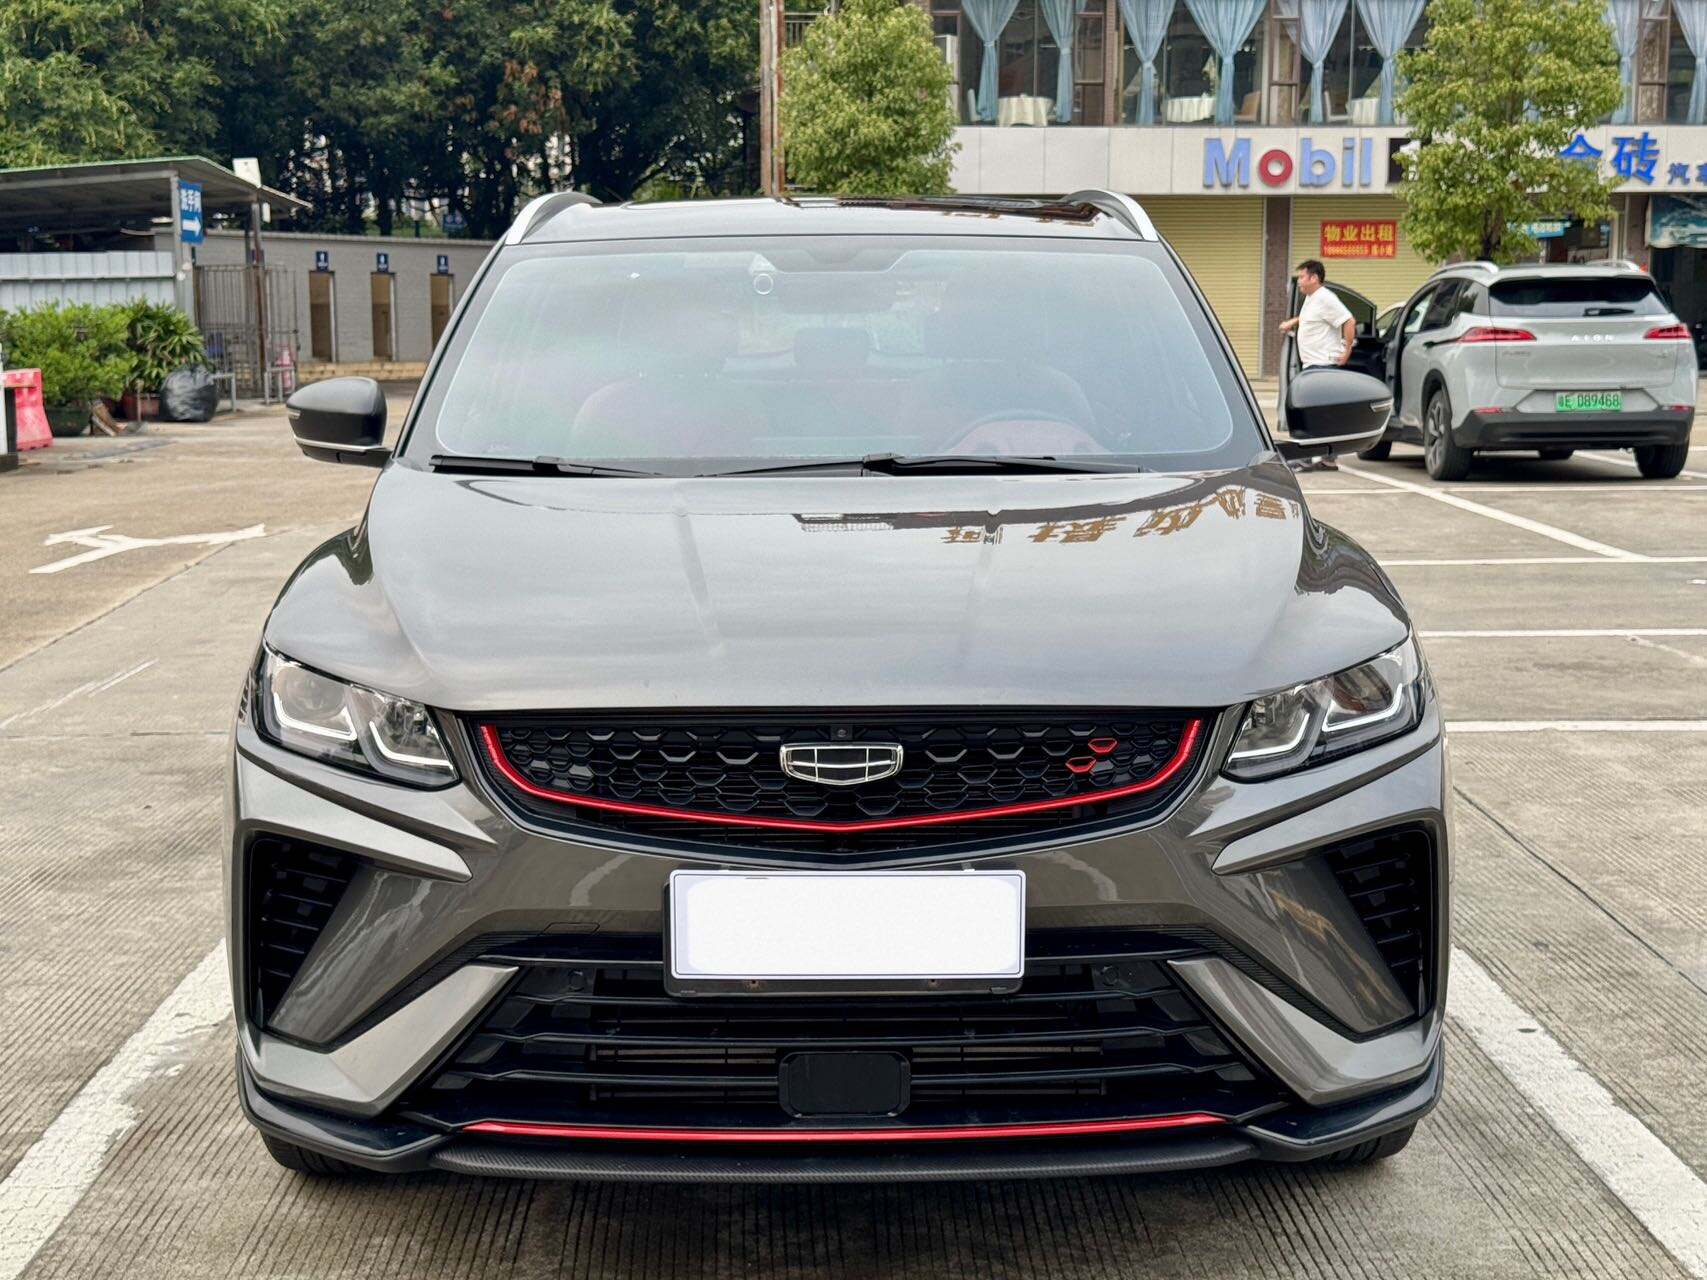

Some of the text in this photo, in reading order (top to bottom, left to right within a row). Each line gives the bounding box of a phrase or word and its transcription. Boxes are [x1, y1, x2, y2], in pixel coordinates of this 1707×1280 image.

[1203, 137, 1373, 188] Mobil
[1324, 223, 1393, 242] 物业出租
